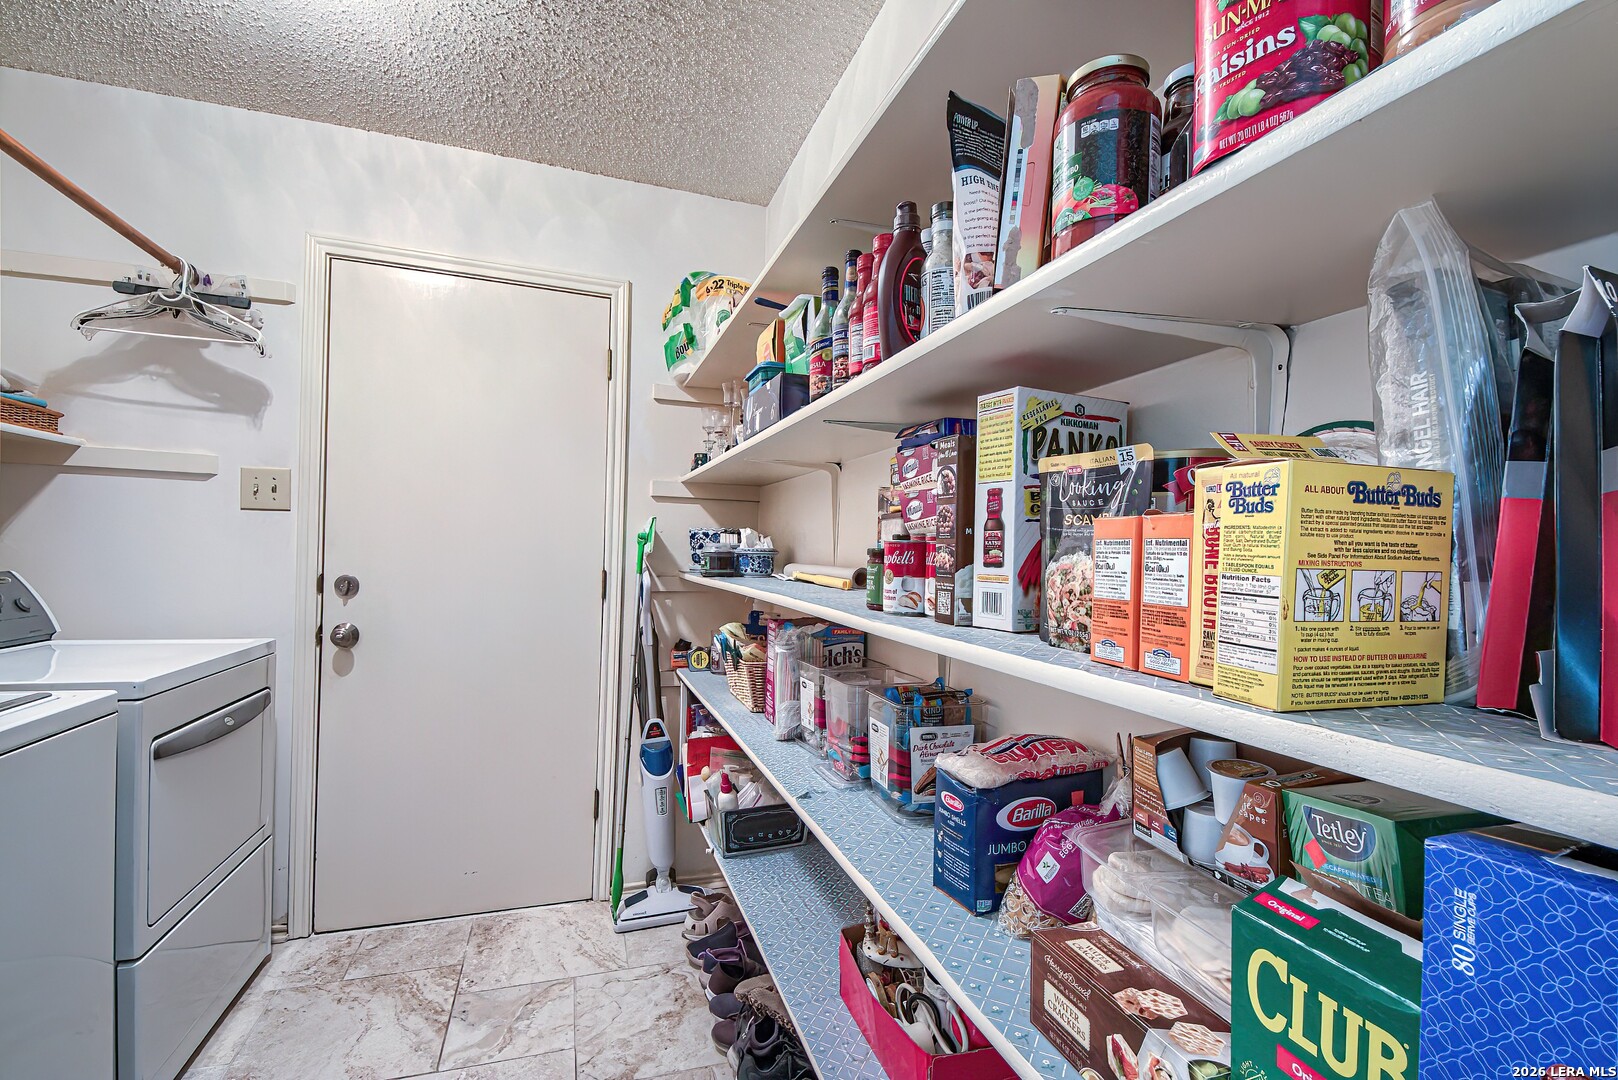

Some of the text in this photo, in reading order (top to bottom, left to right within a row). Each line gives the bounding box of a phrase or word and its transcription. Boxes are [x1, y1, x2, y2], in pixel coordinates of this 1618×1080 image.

[1254, 10, 1270, 22] 1912
[1223, 27, 1261, 52] SUN-DRIED
[1219, 70, 1247, 88] TRUSTED
[1279, 109, 1294, 123] 567g
[961, 175, 986, 187] HIGH
[976, 233, 991, 241] perfect
[1060, 417, 1100, 431] KIKKOMAN
[1410, 370, 1434, 468] NGEL HAIR
[939, 441, 956, 450] Meals
[1119, 451, 1135, 463] 15
[921, 473, 933, 485] RICE
[1238, 470, 1260, 478] natural
[1059, 468, 1126, 510] Cooking
[1225, 480, 1281, 498] Butter
[1304, 480, 1442, 508] ALL ABOUT Butter Buds
[1071, 498, 1105, 507] SAUCE
[1228, 496, 1275, 515] Buds
[1155, 539, 1188, 547] Nutrimental
[1320, 560, 1363, 568] INSTRUCTIONS
[1221, 574, 1250, 582] Nutrition
[1230, 630, 1260, 639] Carbohydrate
[1293, 655, 1309, 663] HOW
[1310, 655, 1318, 663] TO
[1319, 655, 1331, 663] USE
[1366, 653, 1389, 661] BUTTER
[923, 706, 941, 715] KIND
[912, 740, 955, 753] Dark Chocolate
[951, 813, 967, 827] SHELLS
[1012, 803, 1053, 824] Barilla
[1311, 813, 1368, 854] Tetley
[987, 840, 1027, 857] JUMBO
[1059, 841, 1074, 859] EGG
[1323, 862, 1377, 883] ECAFFEINATED
[1267, 898, 1307, 922] Original
[1467, 892, 1477, 946] SERVE CUPS
[1451, 886, 1476, 977] 80 SINGLE
[1072, 942, 1110, 971] CRACKERS
[1053, 992, 1080, 1025] WATER
[1247, 948, 1409, 1080] CLUB
[1047, 999, 1086, 1042] CRACKERS
[1239, 1060, 1254, 1075] LIGHT
